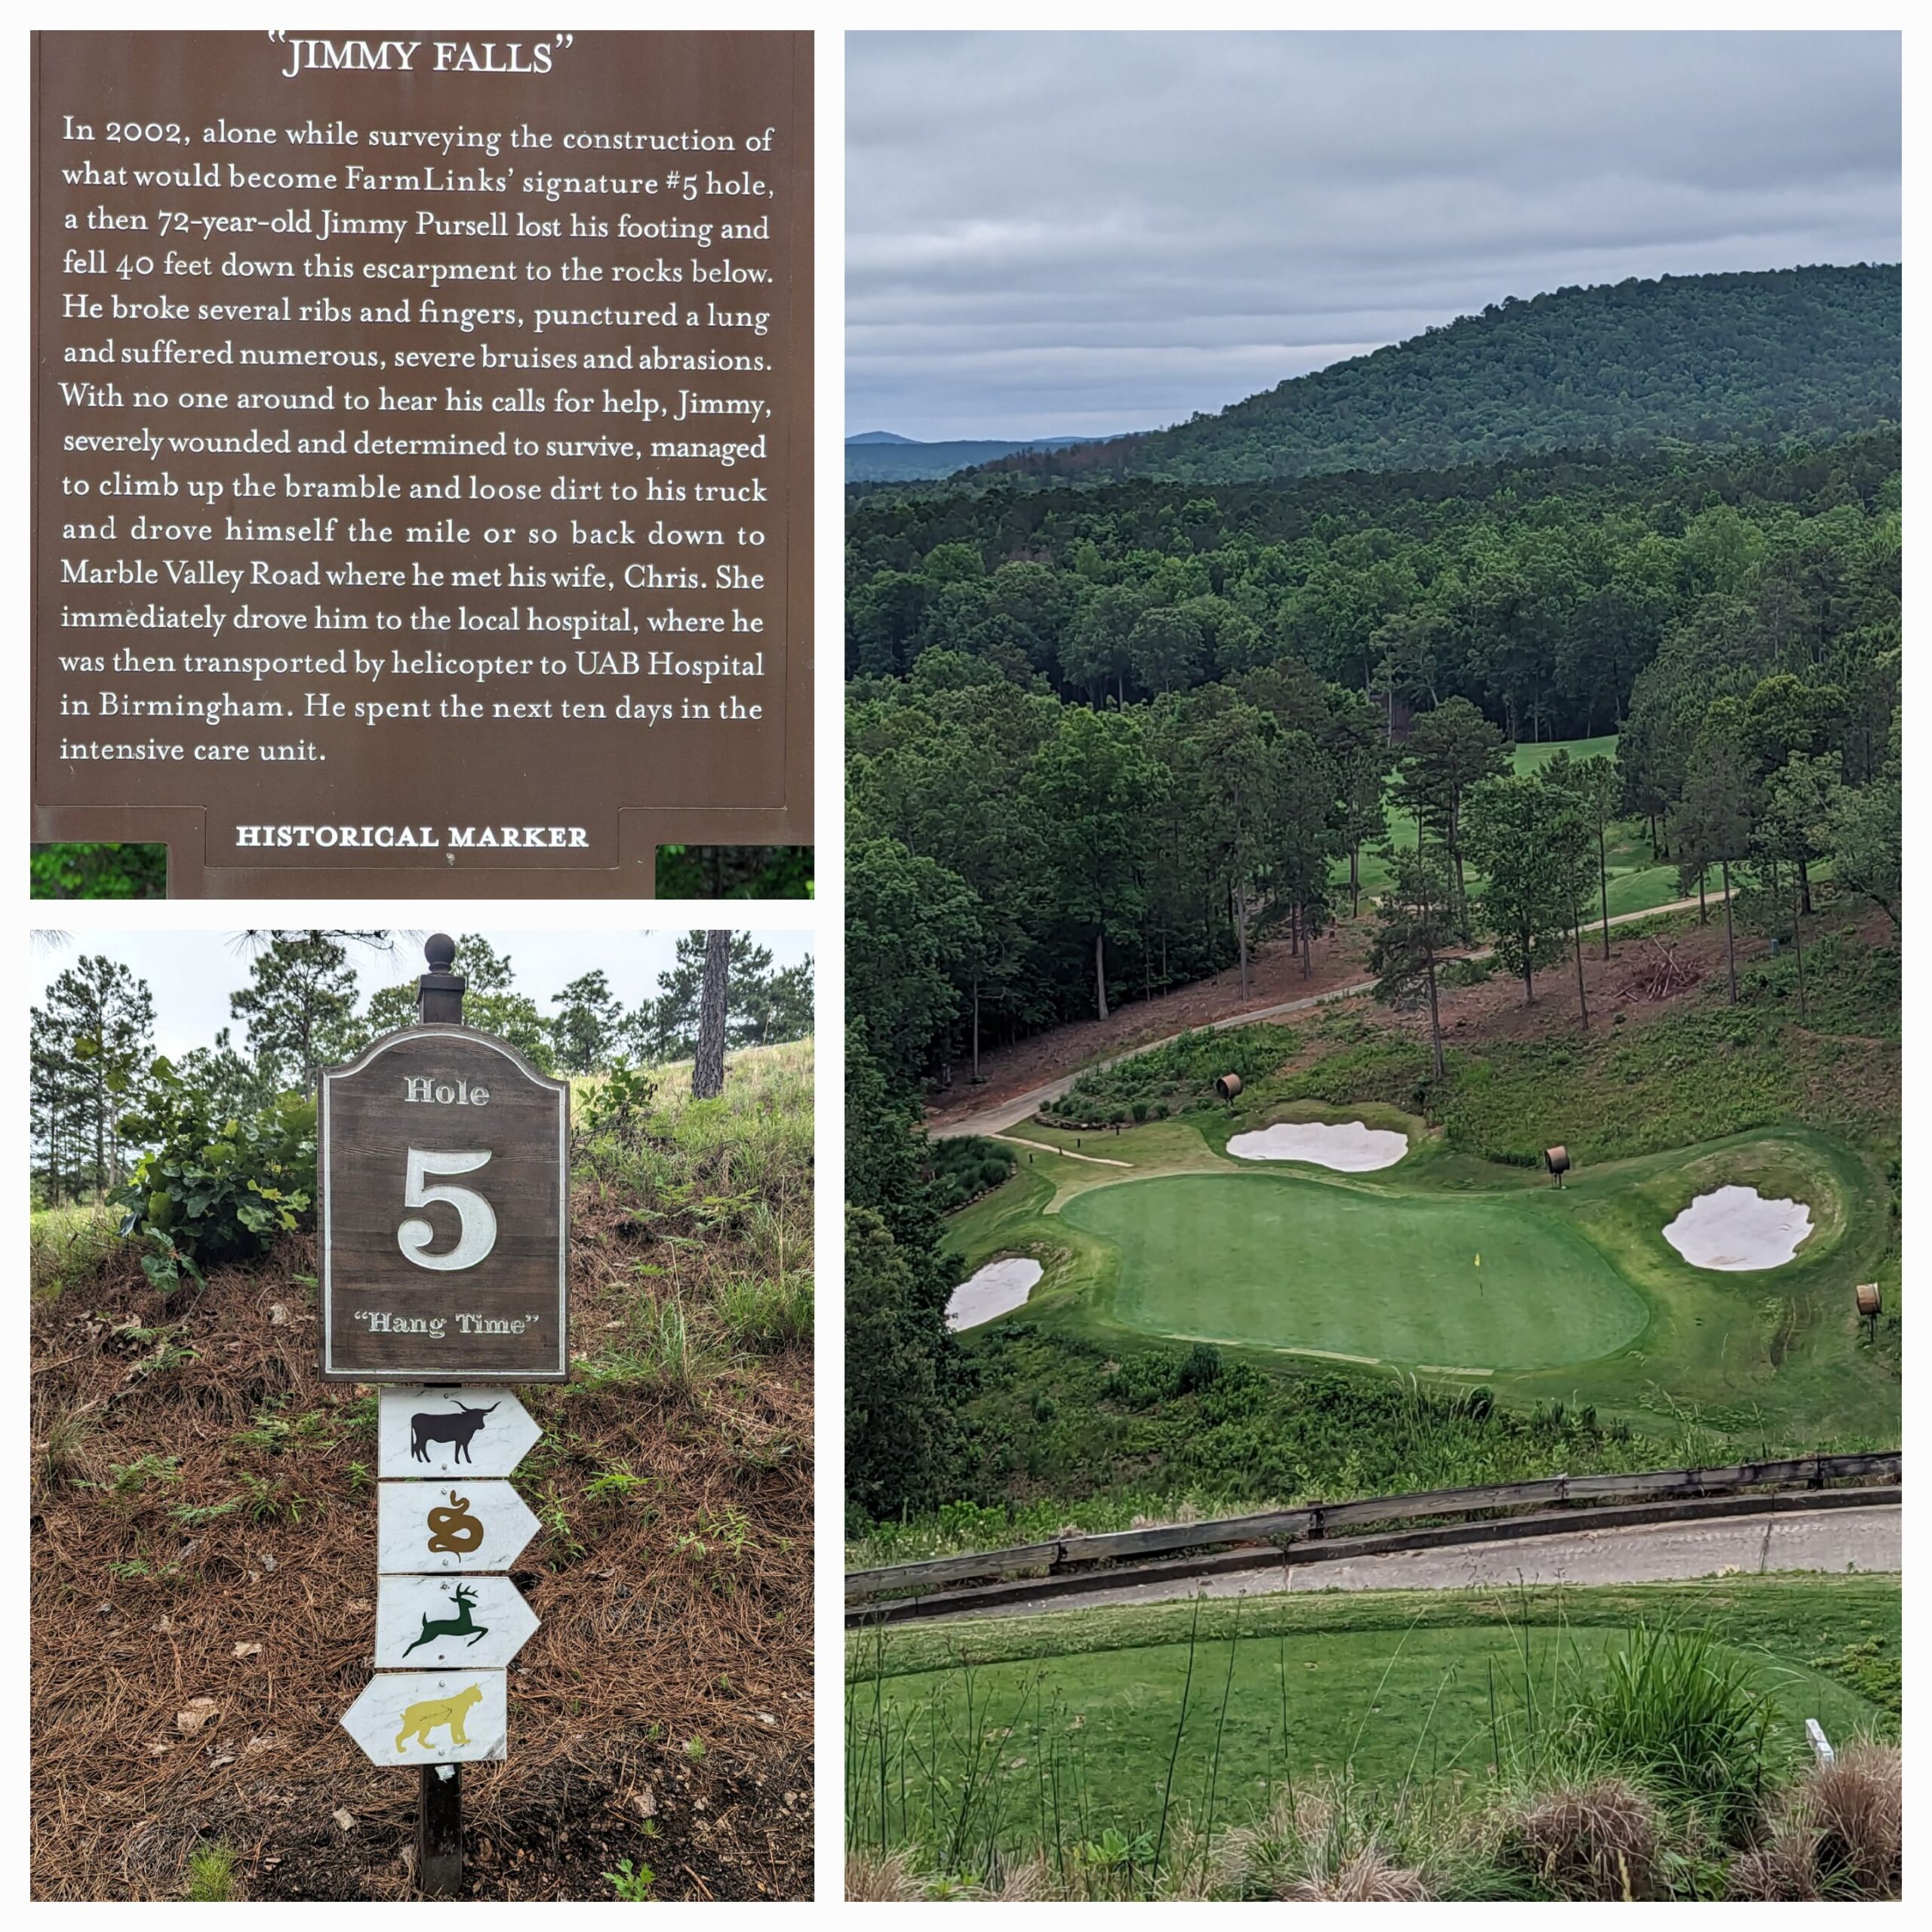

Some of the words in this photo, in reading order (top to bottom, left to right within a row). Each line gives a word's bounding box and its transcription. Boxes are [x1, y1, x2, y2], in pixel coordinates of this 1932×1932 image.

[432, 32, 574, 74] FALLS”
[63, 115, 96, 140] In
[106, 122, 190, 146] 2002,
[203, 118, 277, 144] alone
[285, 119, 358, 146] while
[368, 125, 502, 157] surveying
[509, 123, 553, 149] the
[563, 128, 736, 151] construction
[745, 126, 775, 152] of
[61, 160, 128, 186] what
[132, 162, 222, 188] would
[227, 163, 337, 189] become
[345, 165, 514, 192] FarmLinks’
[523, 171, 658, 202] signature
[666, 170, 698, 201] #5
[705, 170, 774, 199] hole,
[64, 214, 78, 229] a
[87, 205, 149, 230] then
[158, 208, 313, 241] 72-year-old
[315, 209, 408, 244] Jimmy
[415, 211, 509, 236] Pursell
[515, 211, 562, 237] lost
[569, 212, 609, 238] his
[617, 213, 714, 248] footing
[721, 215, 771, 240] and
[63, 248, 108, 274] fell
[115, 254, 154, 281] 40
[163, 250, 213, 276] feet
[221, 251, 296, 277] down
[303, 253, 354, 278] this
[362, 261, 518, 288] escarpment
[525, 261, 552, 281] to
[560, 256, 603, 281] the
[611, 257, 683, 283] rocks
[690, 258, 773, 284] below.
[62, 293, 103, 318] He
[110, 294, 190, 320] broke
[198, 296, 292, 321] several
[298, 297, 352, 322] ribs
[359, 298, 411, 323] and
[419, 299, 524, 333] fingers,
[534, 301, 678, 334] punctured
[686, 311, 700, 327] a
[707, 302, 771, 336] lung
[63, 338, 115, 363] and
[121, 338, 235, 365] suffered
[239, 349, 386, 371] numerous,
[394, 351, 475, 368] severe
[480, 343, 577, 369] bruises
[583, 345, 634, 370] and
[638, 345, 772, 371] abrasions.
[57, 382, 125, 408] With
[132, 392, 169, 408] no
[178, 392, 229, 409] one
[236, 385, 336, 410] around
[343, 391, 370, 411] to
[377, 386, 438, 411] hear
[445, 386, 483, 412] his
[491, 387, 546, 413] calls
[553, 388, 595, 413] for
[601, 388, 667, 422] help,
[672, 389, 771, 423] Jimmy,
[63, 427, 163, 462] severely
[168, 429, 293, 455] wounded
[297, 429, 348, 454] and
[353, 429, 508, 456] determined
[512, 437, 540, 457] to
[546, 435, 643, 462] survive,
[650, 434, 768, 467] managed
[61, 476, 90, 496] to
[99, 471, 179, 497] climb
[186, 481, 224, 505] up
[232, 472, 276, 497] the
[283, 472, 401, 499] bramble
[409, 474, 462, 500] and
[469, 475, 542, 500] loose
[550, 475, 603, 501] dirt
[610, 481, 638, 501] to
[645, 476, 687, 502] his
[694, 477, 768, 502] truck
[63, 515, 118, 540] and
[131, 515, 213, 541] drove
[224, 515, 339, 542] himself
[347, 517, 393, 543] the
[405, 518, 470, 543] mile
[483, 528, 516, 543] or
[528, 528, 558, 544] so
[570, 519, 636, 545] back
[648, 520, 725, 545] down
[737, 527, 765, 546] to
[60, 558, 158, 584] Marble
[162, 559, 245, 594] Valley
[250, 561, 321, 586] Road
[325, 561, 406, 586] where
[411, 561, 445, 587] he
[451, 568, 503, 587] met
[507, 561, 546, 588] his
[550, 563, 614, 592] wife,
[624, 563, 707, 589] Chris.
[715, 565, 764, 589] She
[60, 603, 227, 638] immediately
[233, 604, 307, 629] drove
[314, 605, 369, 629] him
[375, 611, 402, 630] to
[410, 605, 451, 631] the
[457, 605, 521, 631] local
[526, 606, 638, 640] hospital,
[646, 608, 725, 632] where
[731, 608, 764, 633] he
[57, 656, 105, 672] was
[112, 647, 177, 672] then
[183, 648, 347, 681] transported
[353, 649, 386, 683] by
[391, 649, 534, 683] helicopter
[540, 656, 567, 675] to
[574, 651, 640, 675] UAB
[647, 651, 765, 685] Hospital
[60, 694, 91, 715] in
[98, 691, 294, 726] Birmingham.
[304, 693, 346, 718] He
[355, 699, 432, 726] spent
[439, 693, 484, 718] the
[492, 700, 553, 718] next
[561, 700, 608, 718] ten
[615, 694, 673, 728] days
[681, 697, 711, 719] in
[718, 694, 762, 720] the
[60, 737, 185, 761] intensive
[194, 745, 250, 761] care
[257, 739, 326, 761] unit.
[235, 825, 440, 848] HISTORICAL
[448, 826, 590, 848] MARKER
[404, 1075, 491, 1106] Hole
[397, 1146, 498, 1272] 5
[353, 1310, 448, 1340] “Hang
[455, 1313, 540, 1335] Time”
